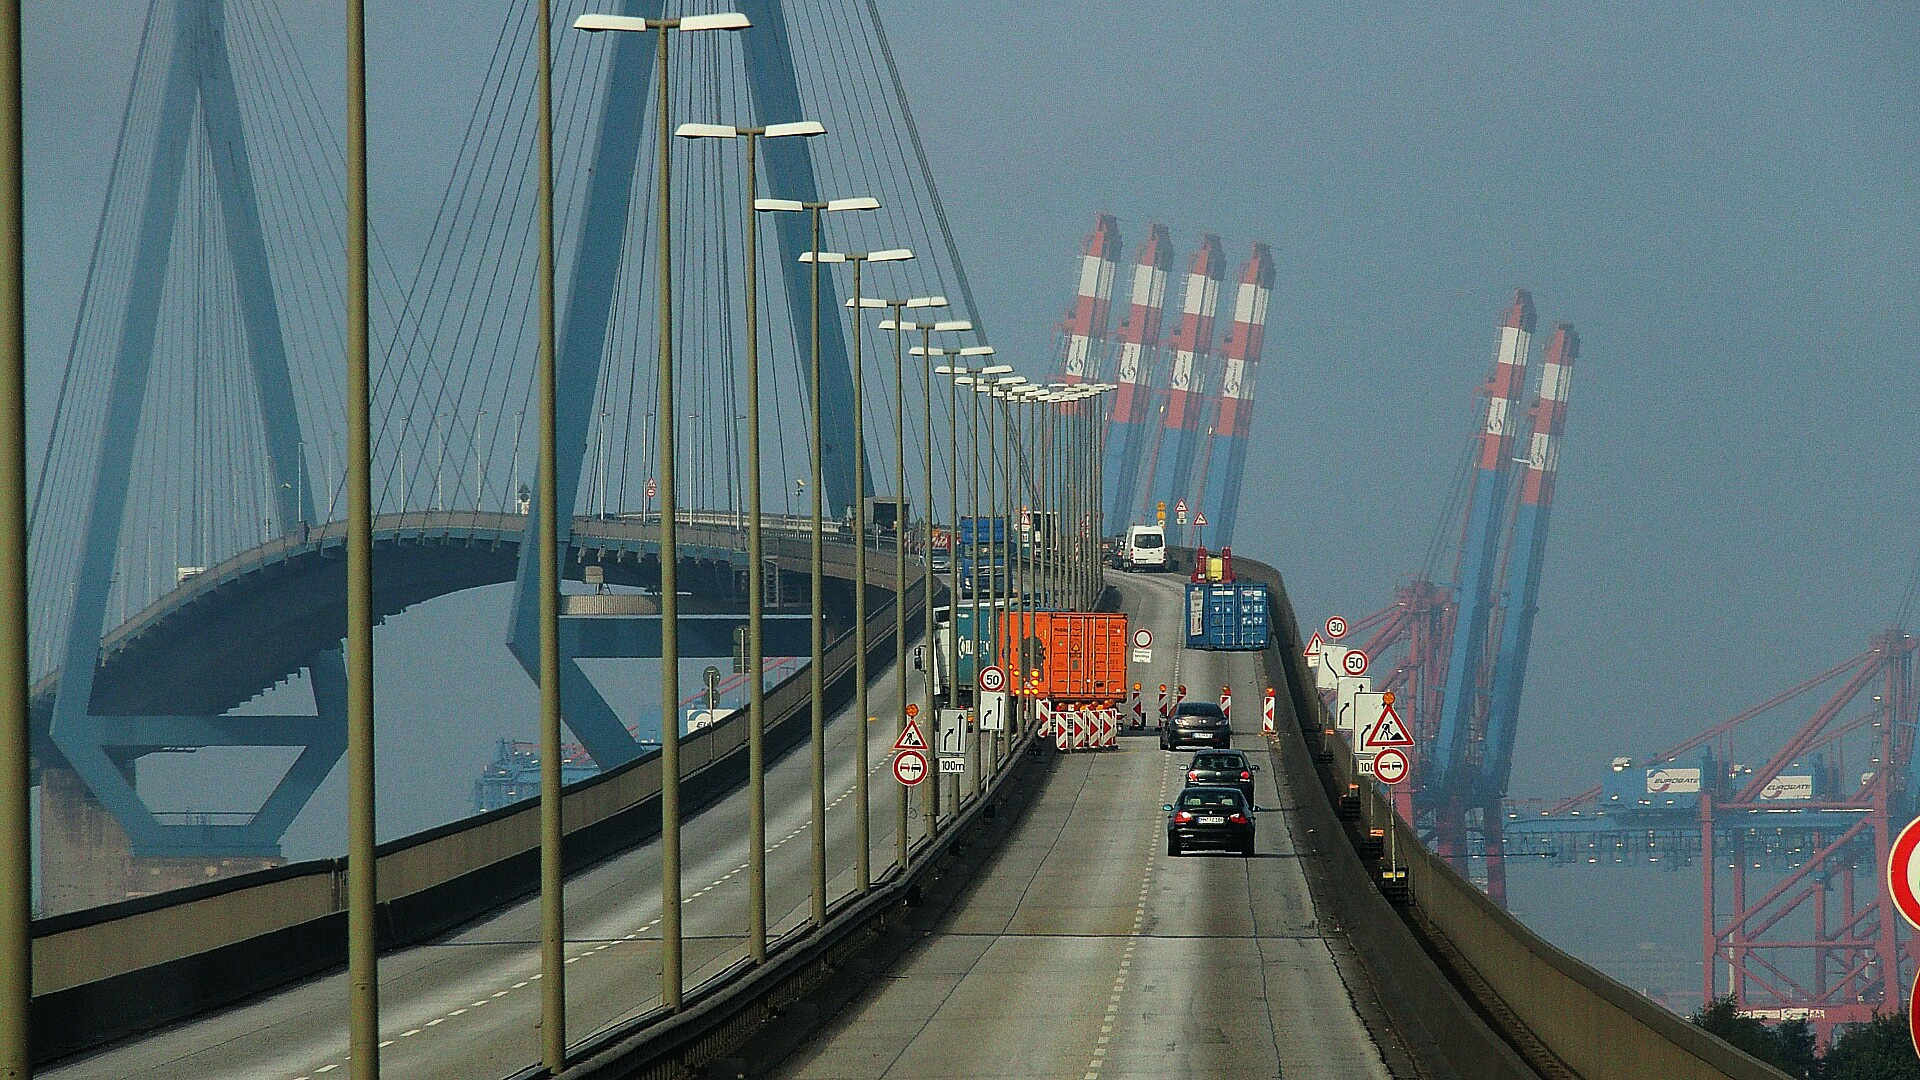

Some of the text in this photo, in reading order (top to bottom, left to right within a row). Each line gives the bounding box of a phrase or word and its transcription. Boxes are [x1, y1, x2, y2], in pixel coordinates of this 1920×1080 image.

[1331, 621, 1343, 632] 30
[1348, 657, 1363, 669] 50
[986, 674, 999, 685] 50
[941, 760, 965, 771] 100m
